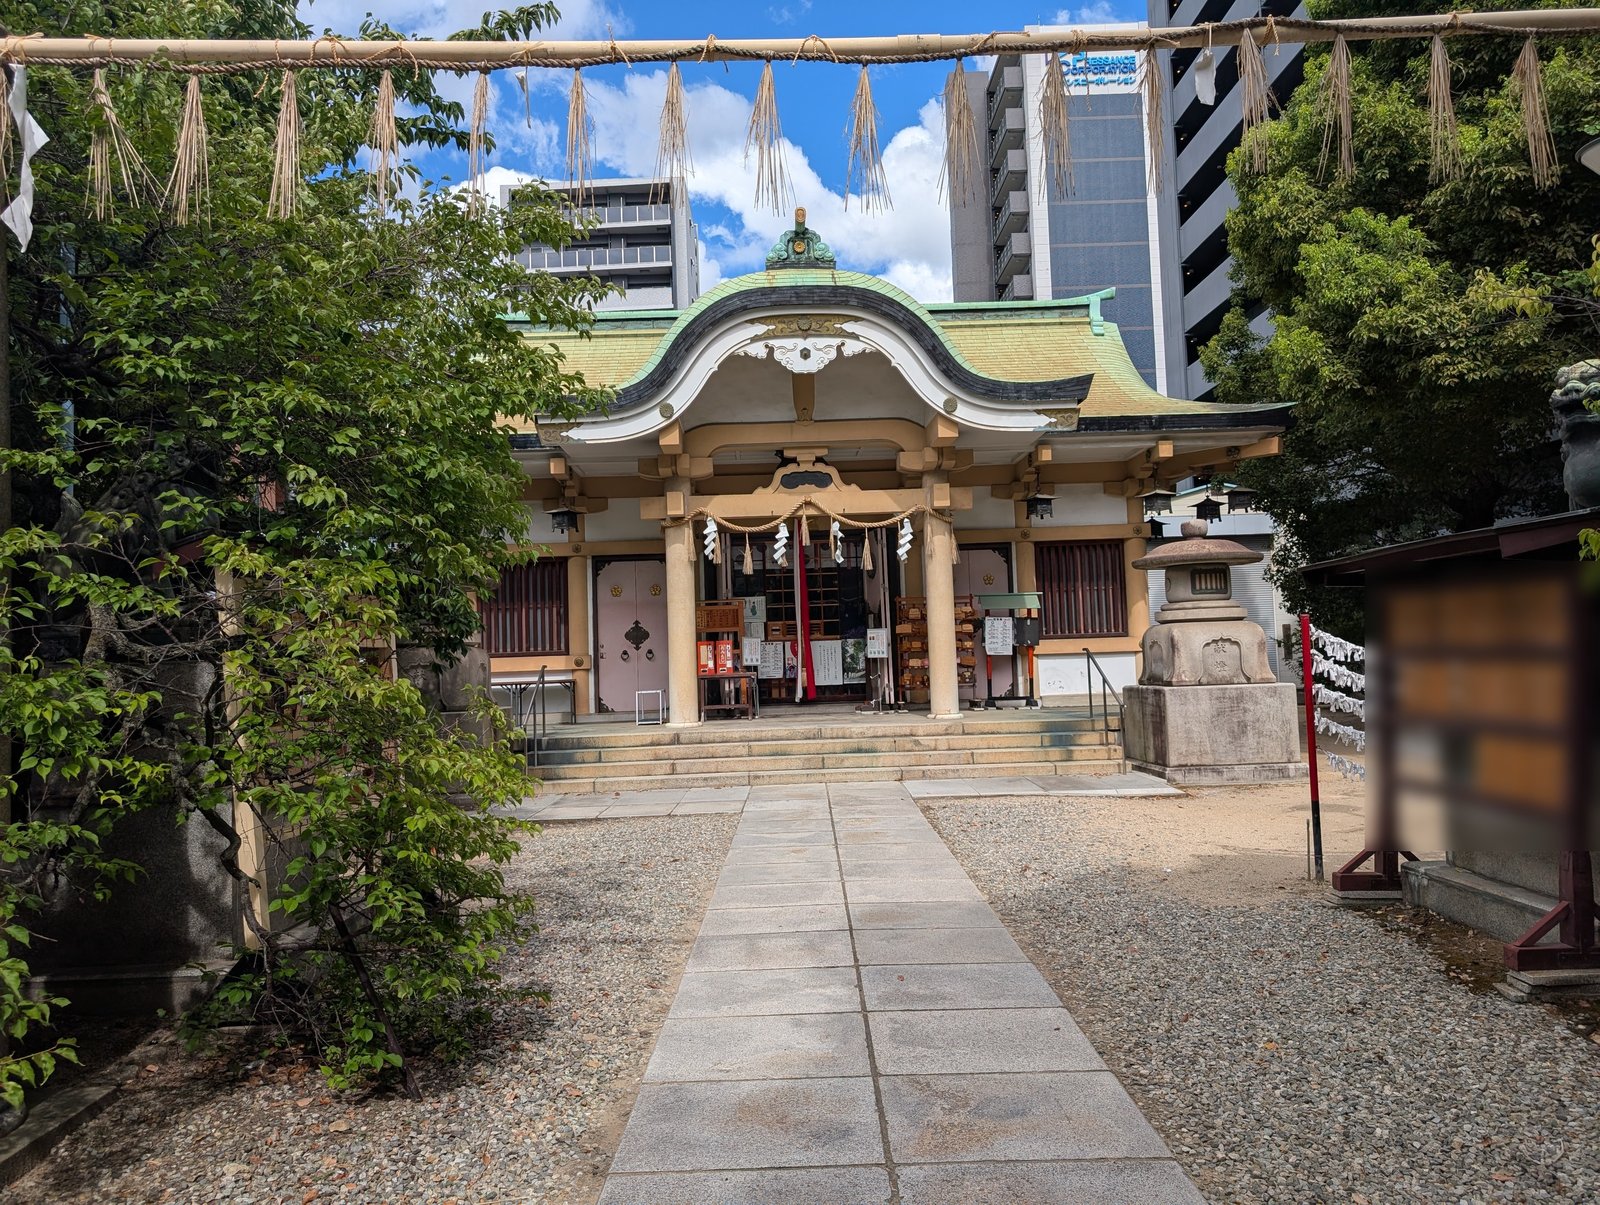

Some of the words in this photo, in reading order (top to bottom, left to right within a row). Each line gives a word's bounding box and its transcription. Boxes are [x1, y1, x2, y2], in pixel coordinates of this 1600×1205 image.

[1066, 76, 1136, 87] ンスコーポレーション
